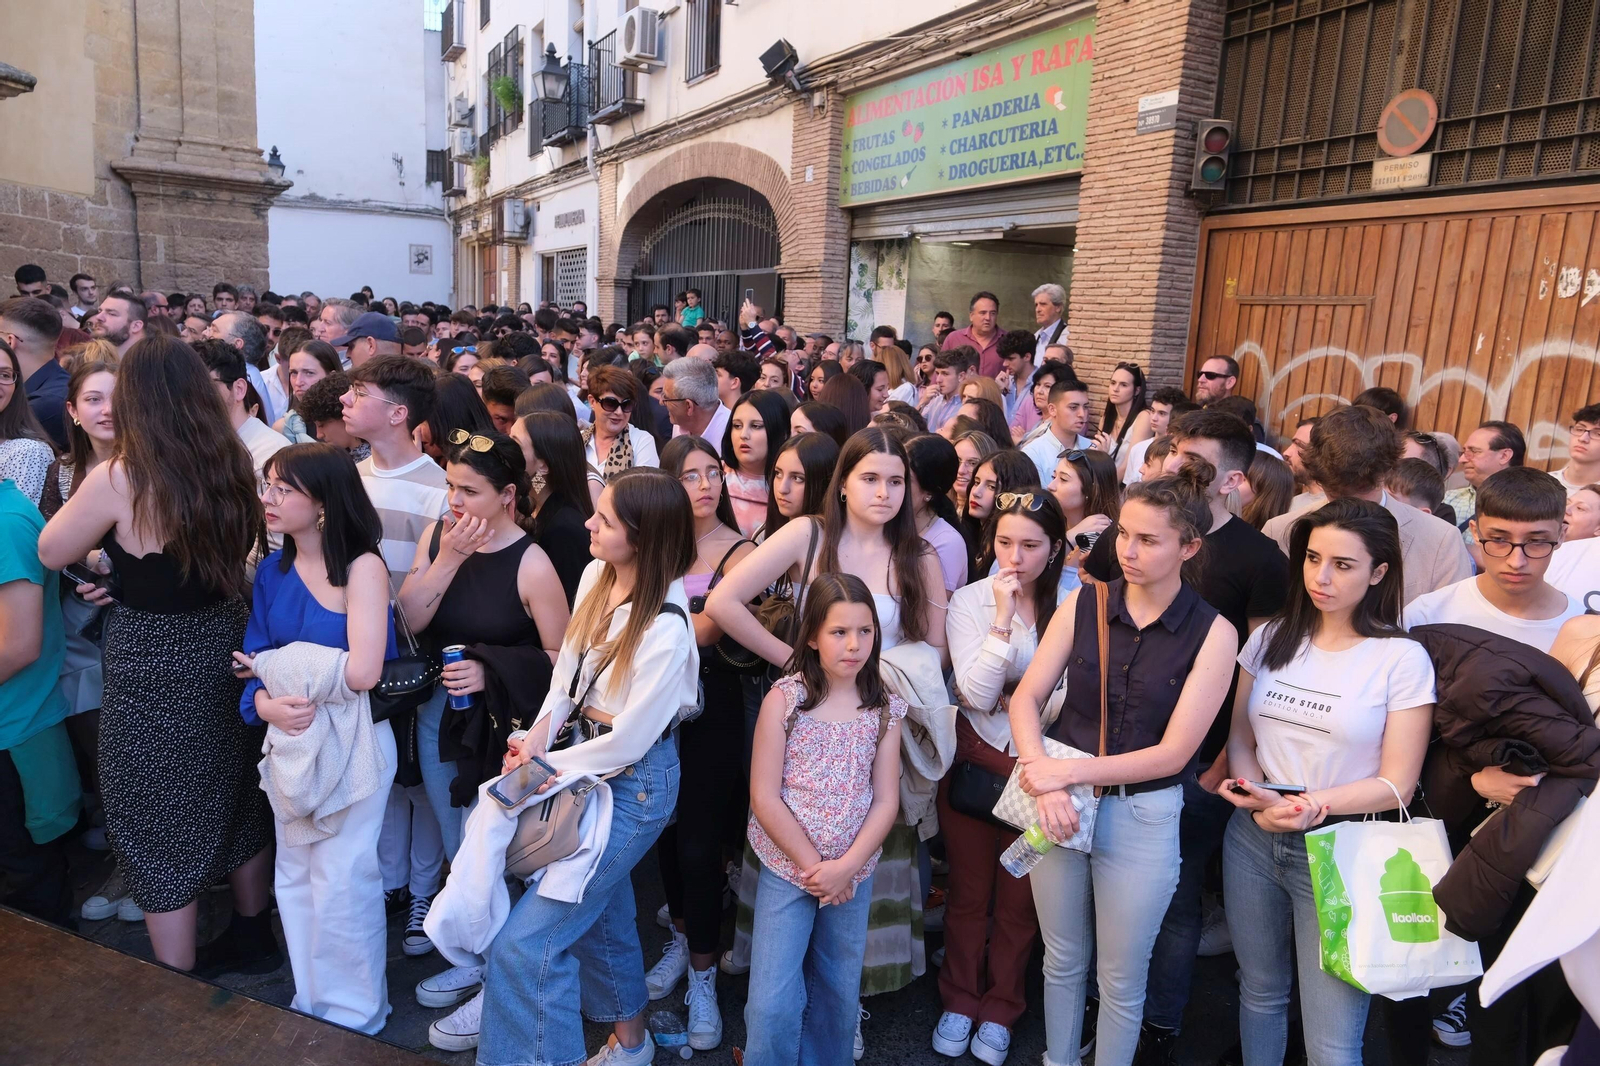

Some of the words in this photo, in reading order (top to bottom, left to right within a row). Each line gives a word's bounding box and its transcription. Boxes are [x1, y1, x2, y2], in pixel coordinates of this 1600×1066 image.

[847, 70, 968, 128] ALIMENTACIÓN
[972, 62, 1004, 93] ISA
[1010, 54, 1027, 81] Y
[1030, 34, 1094, 76] RAFA
[952, 92, 1041, 129] PANADERIA
[852, 130, 895, 153] FRUTAS
[949, 117, 1059, 156] CHARCUTERIA
[851, 146, 926, 175] CONGELADOS
[1384, 161, 1419, 172] PERMISO
[850, 175, 897, 196] BEBIDAS
[1263, 699, 1298, 713] EDITION
[1302, 710, 1323, 720] NO.1
[1266, 690, 1296, 704] SESTO
[1299, 699, 1332, 713] STADO
